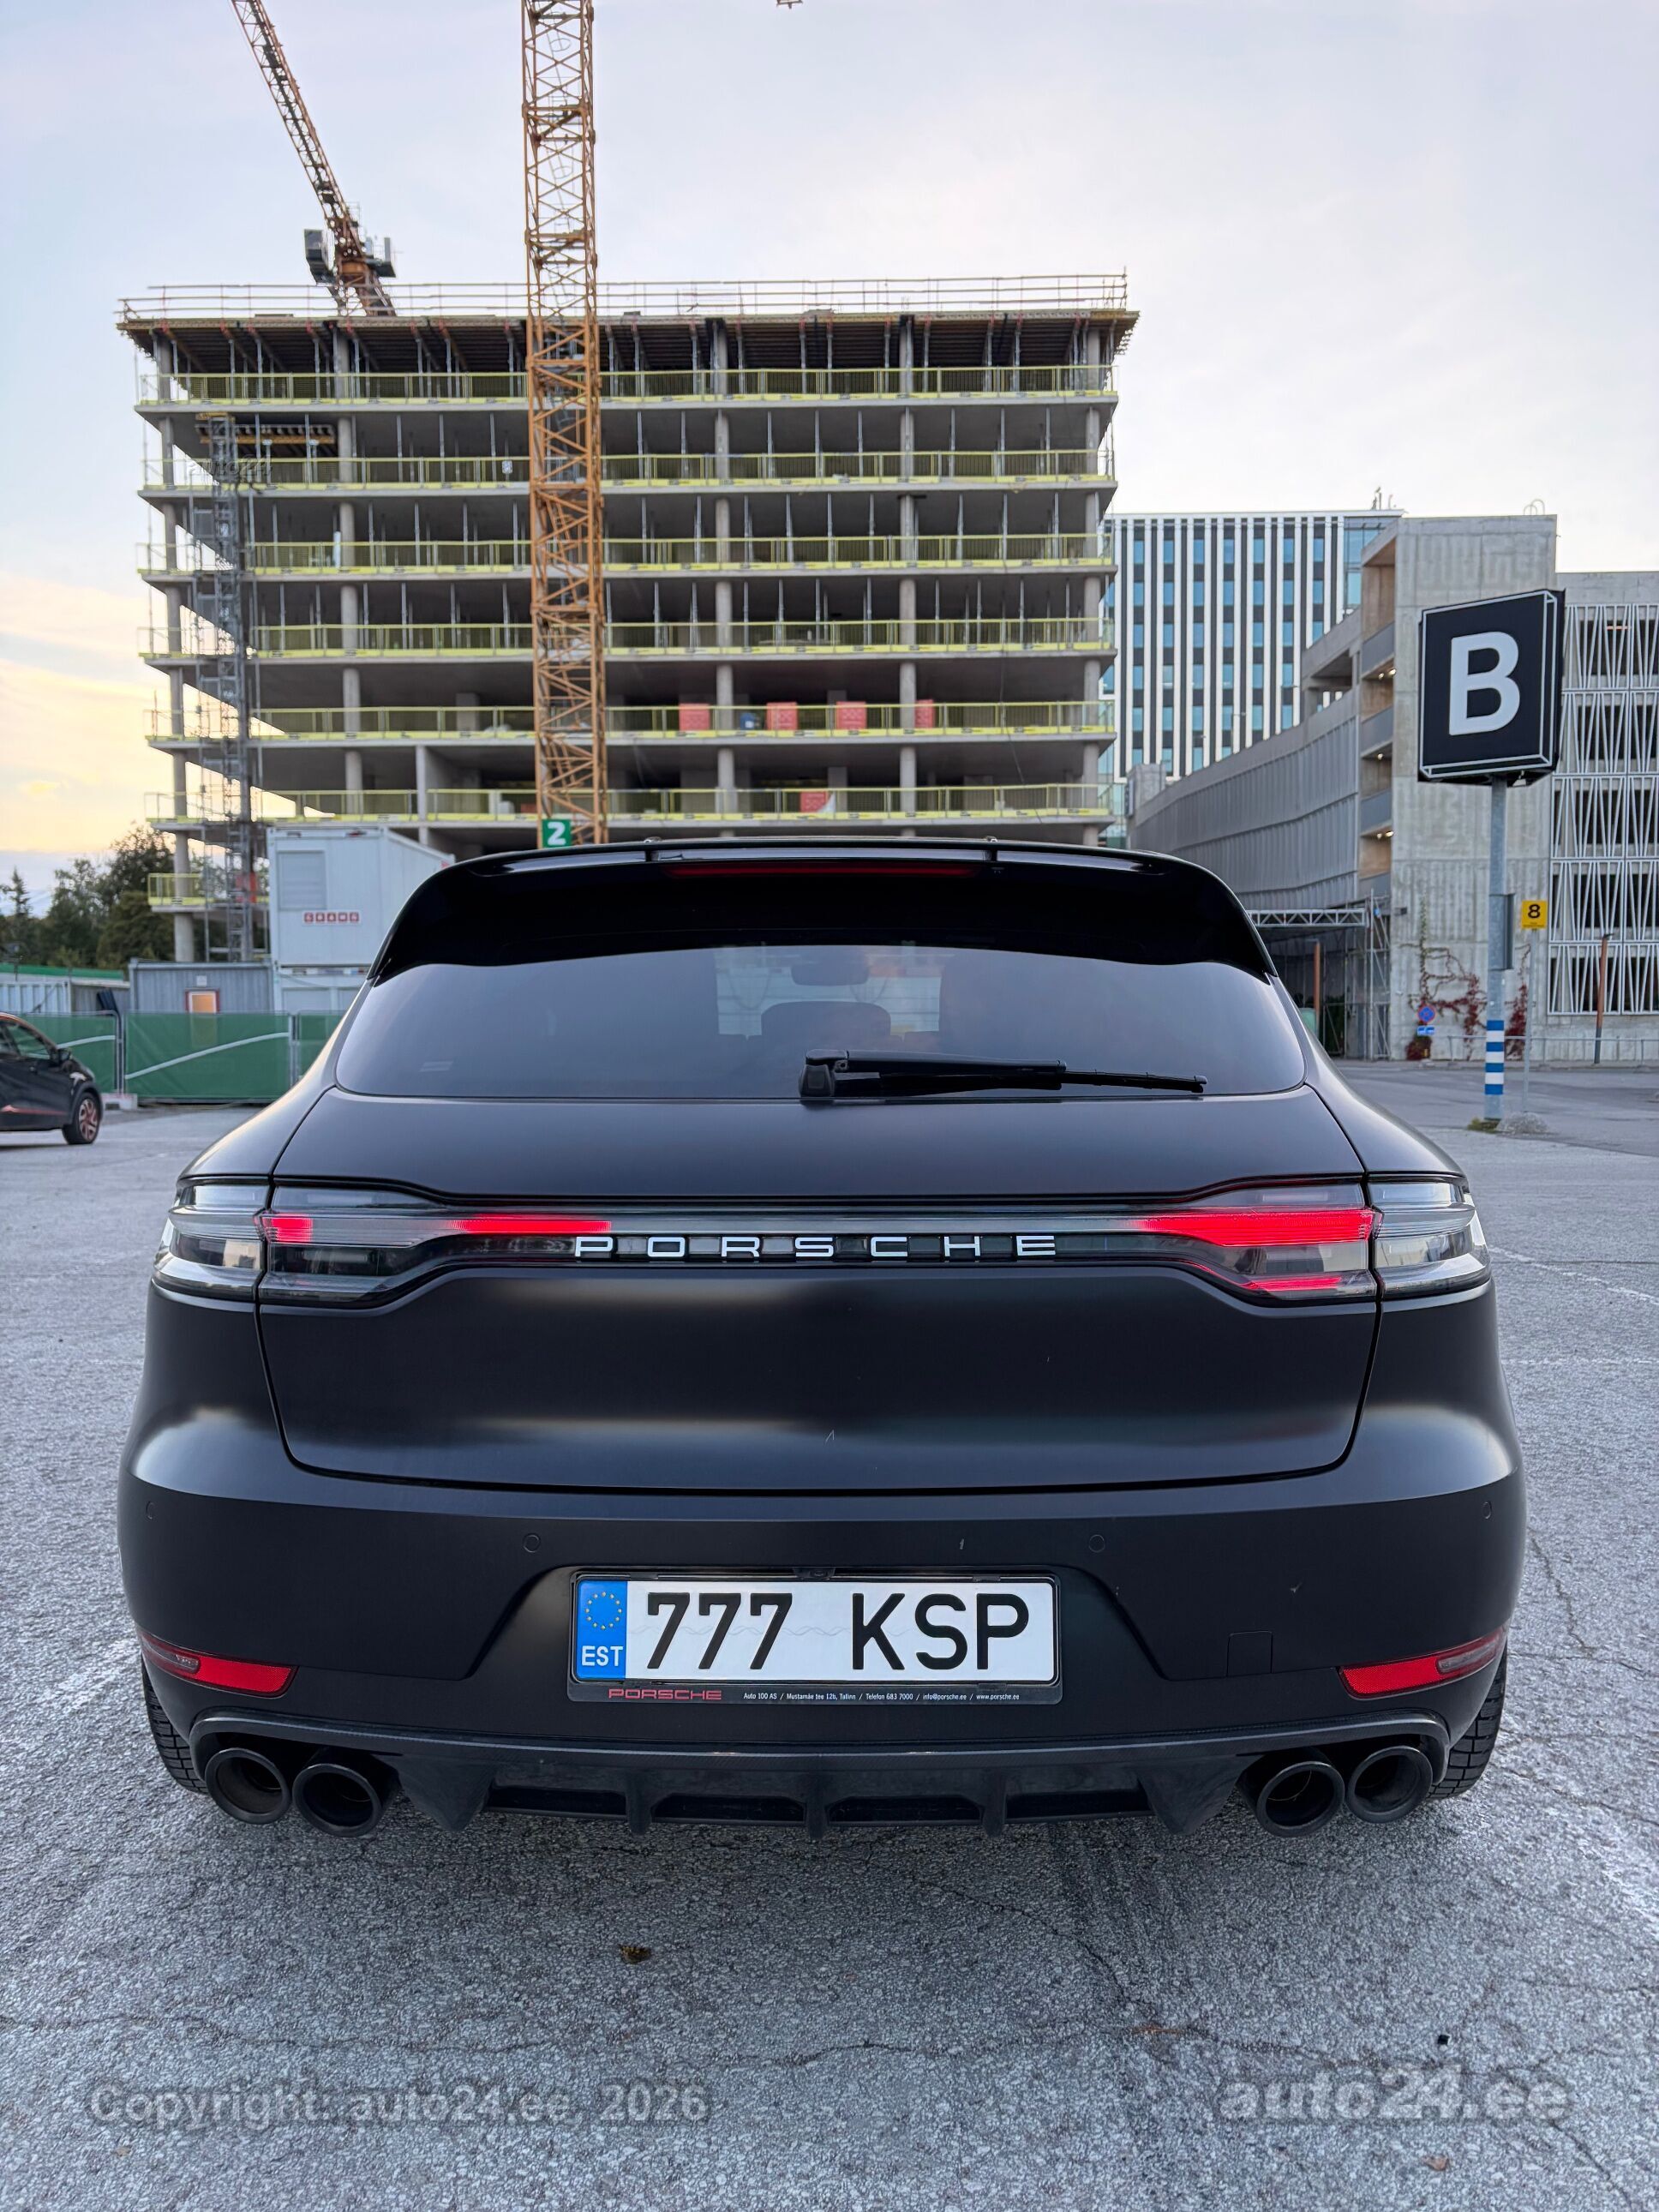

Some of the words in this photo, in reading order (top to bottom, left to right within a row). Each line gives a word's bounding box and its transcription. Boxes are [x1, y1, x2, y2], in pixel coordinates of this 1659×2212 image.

[1449, 631, 1520, 735] B
[547, 821, 566, 846] 2
[1528, 903, 1541, 919] 8
[574, 1236, 1056, 1258] PORSCHE
[646, 1592, 793, 1669] 777
[852, 1592, 1029, 1670] KSP
[581, 1646, 623, 1667] EST
[608, 1688, 722, 1700] PORSCHE
